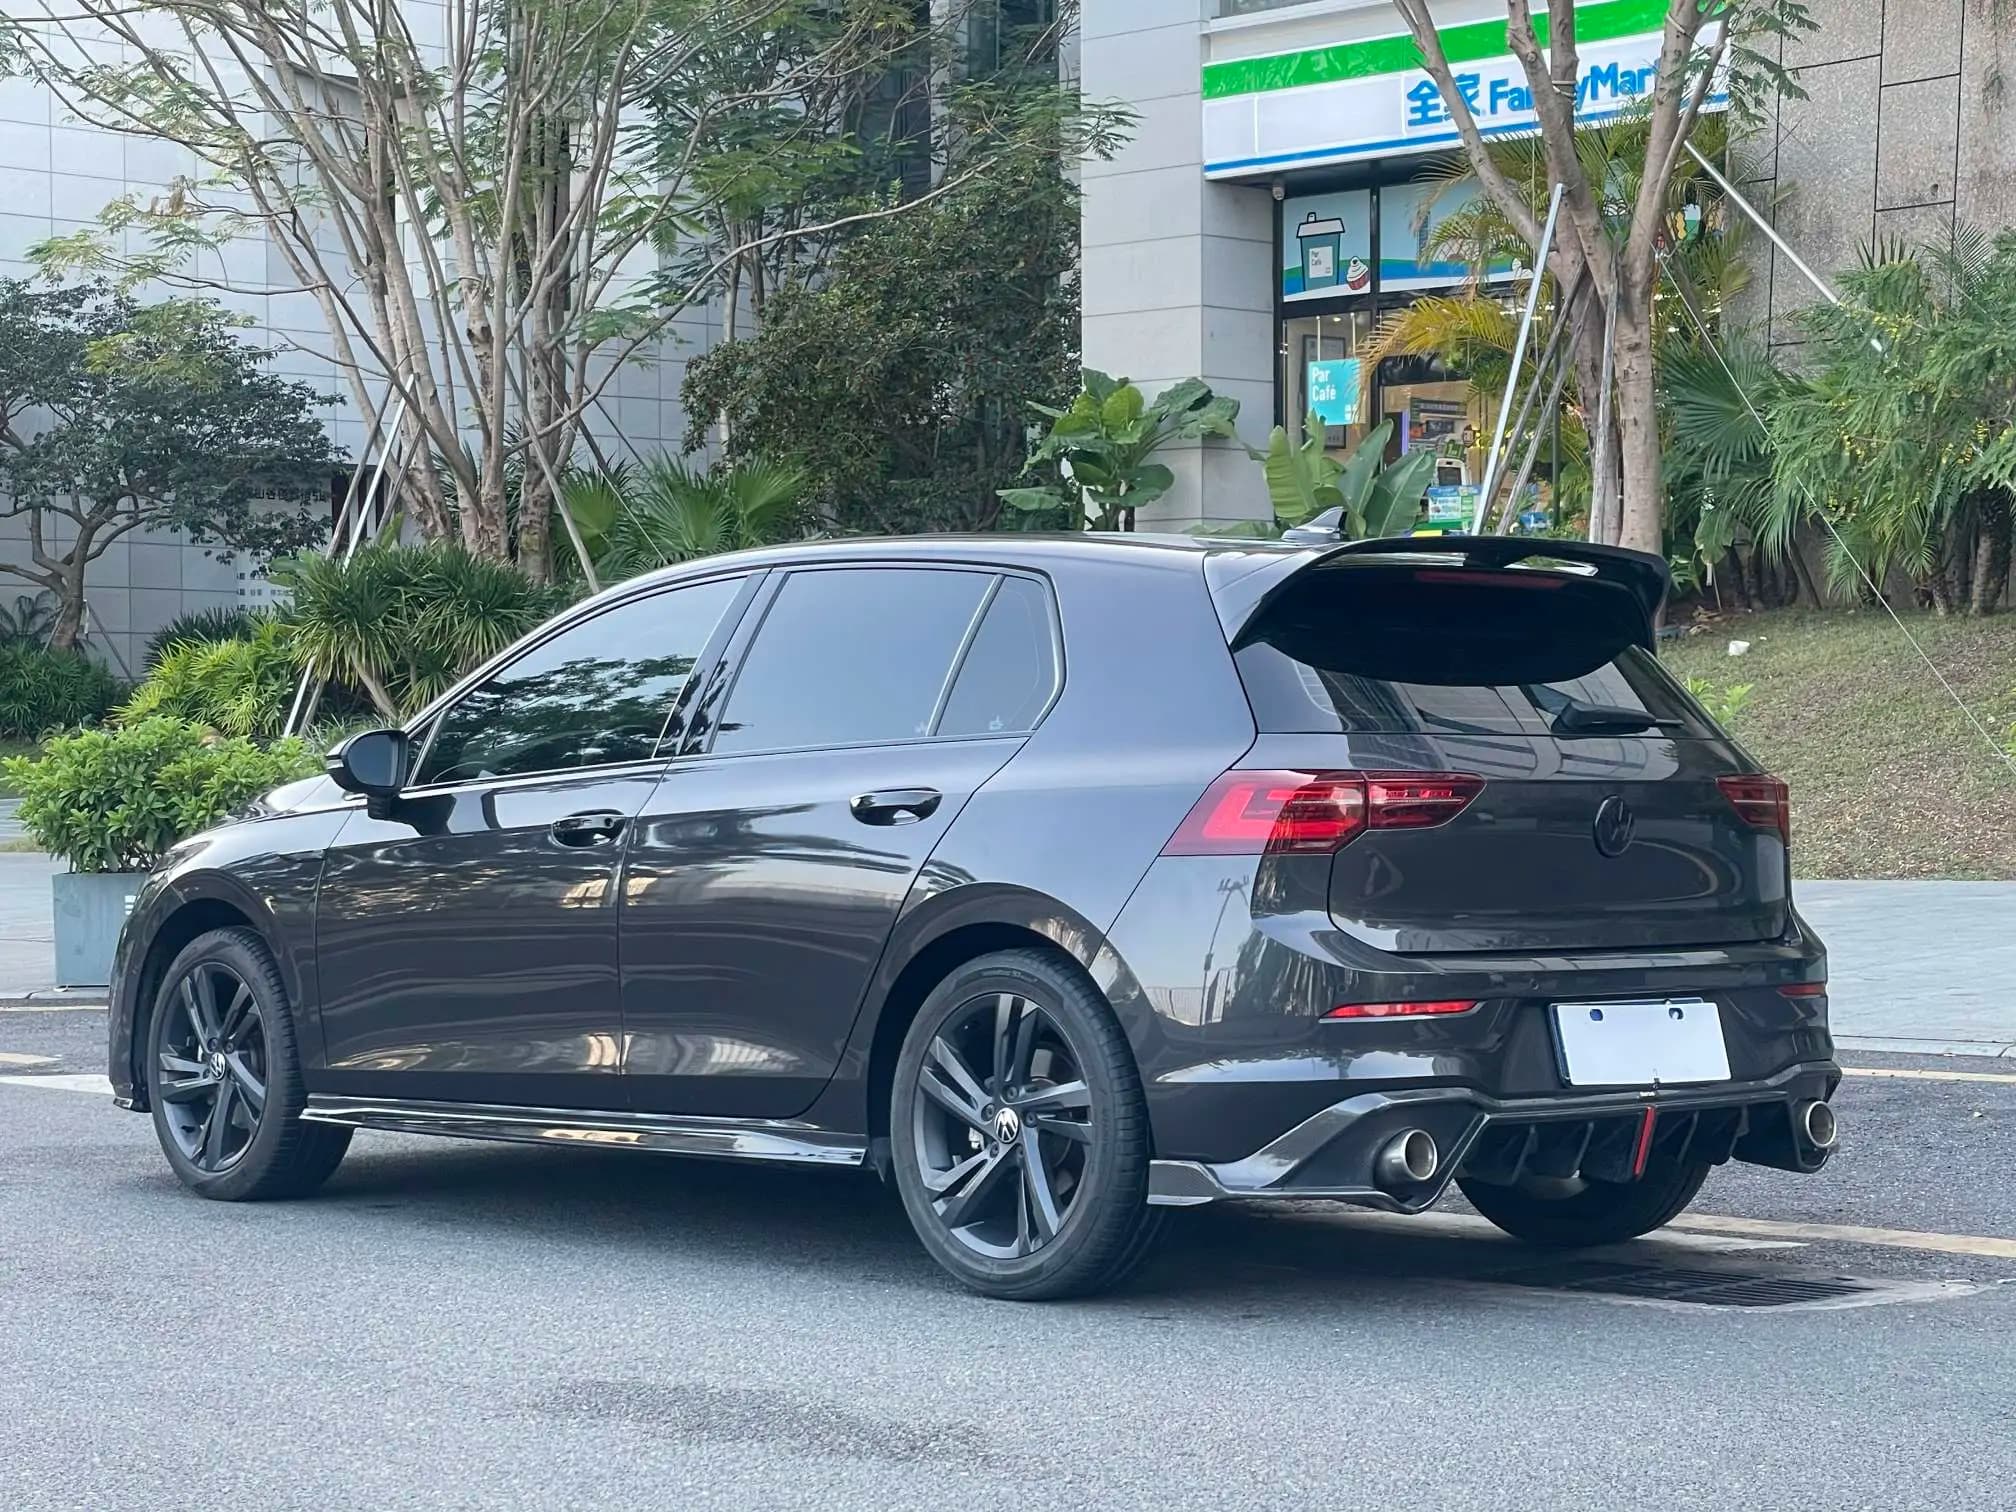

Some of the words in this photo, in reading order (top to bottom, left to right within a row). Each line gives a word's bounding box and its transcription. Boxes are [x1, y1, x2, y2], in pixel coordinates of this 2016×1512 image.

[1490, 57, 1664, 115] FayMar
[1312, 366, 1330, 383] Par
[1312, 384, 1336, 401] Café
